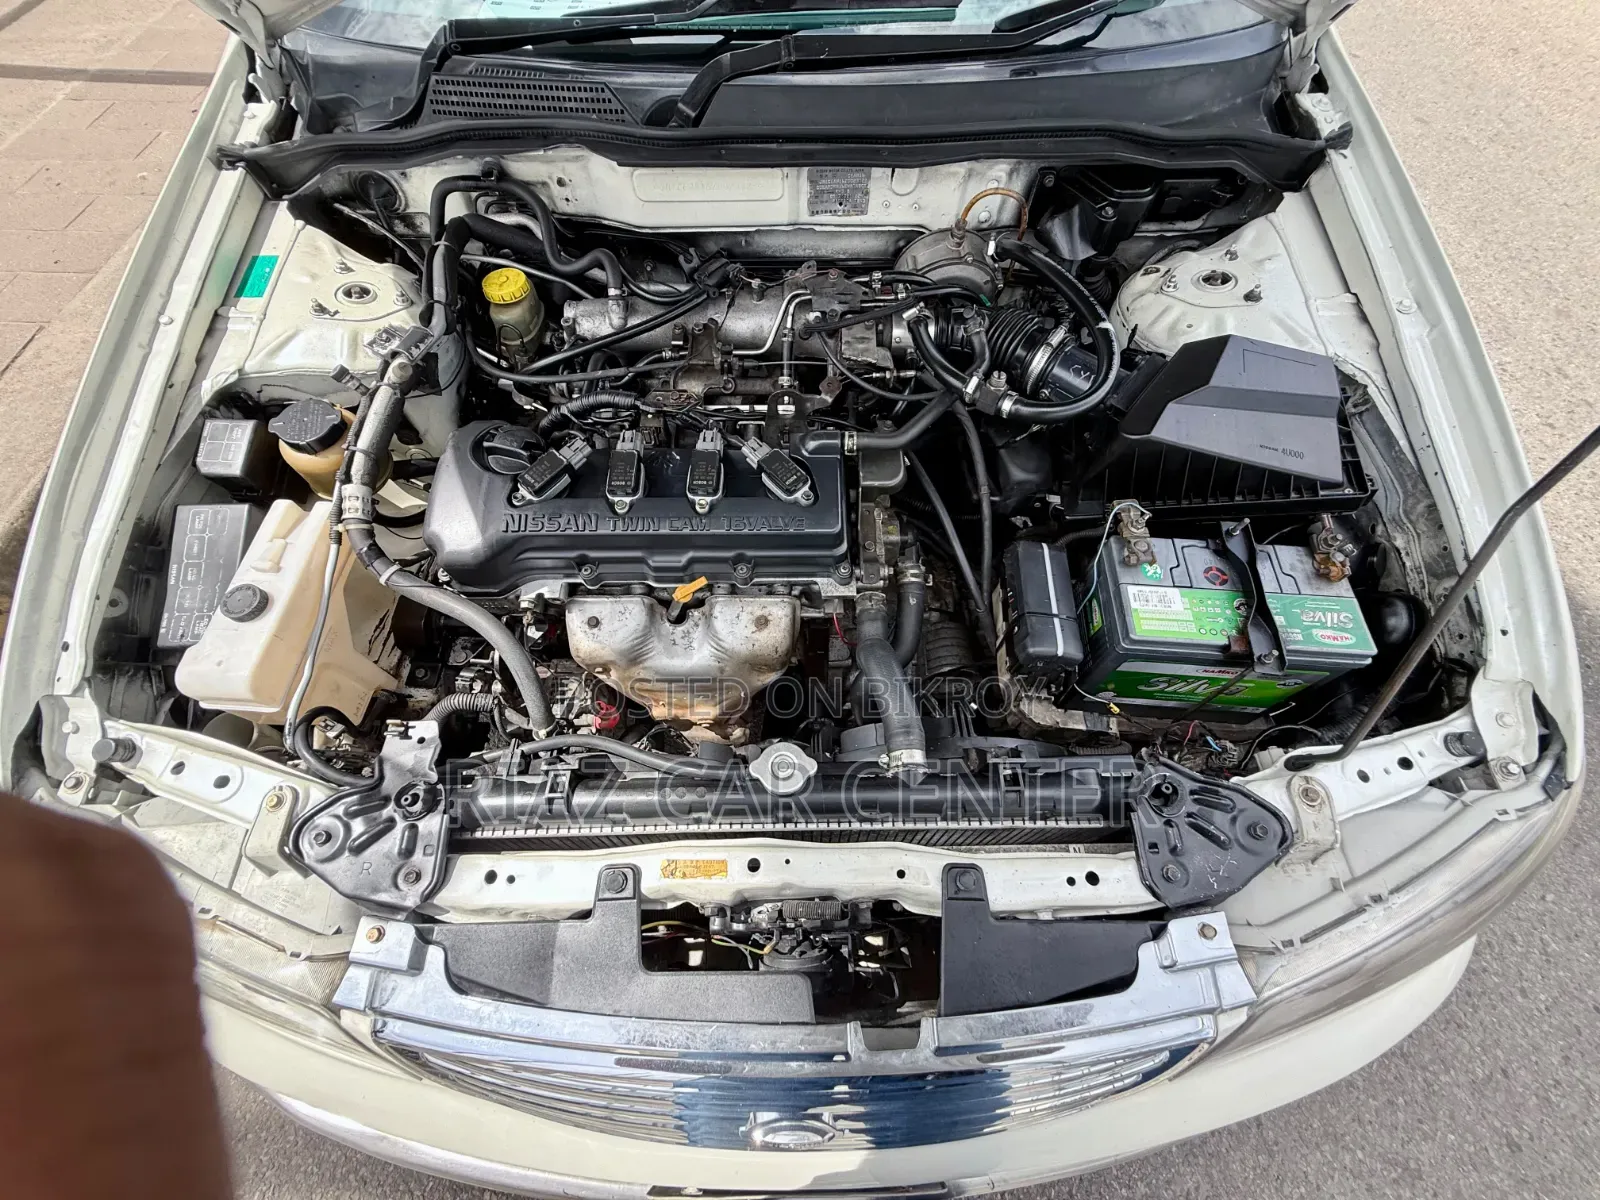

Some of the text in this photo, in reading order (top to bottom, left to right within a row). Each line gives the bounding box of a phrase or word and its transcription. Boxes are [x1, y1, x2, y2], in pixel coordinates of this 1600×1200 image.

[1281, 447, 1304, 460] 4U000
[501, 513, 806, 533] NISSAN TWIN CAM 16VALVE
[1302, 610, 1354, 628] Silva
[1319, 633, 1350, 642] HAMKO
[360, 861, 373, 876] R
